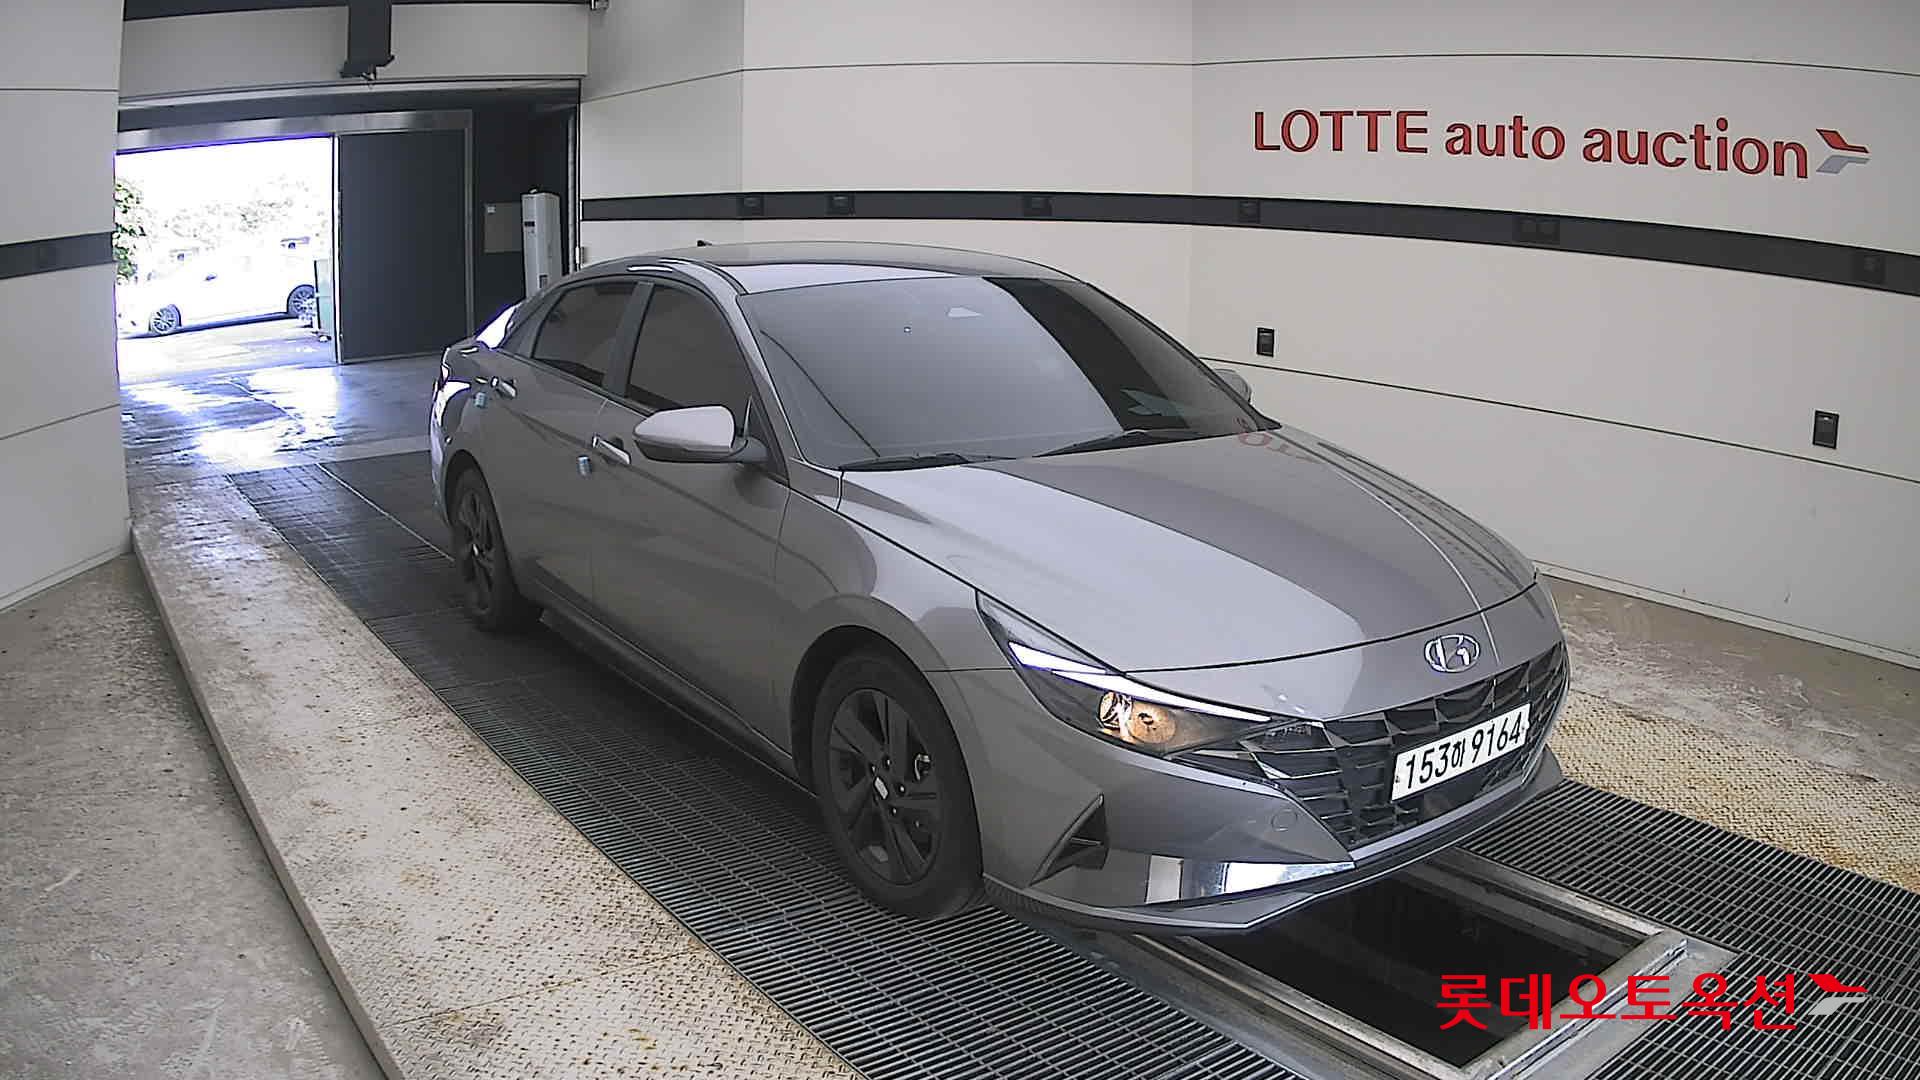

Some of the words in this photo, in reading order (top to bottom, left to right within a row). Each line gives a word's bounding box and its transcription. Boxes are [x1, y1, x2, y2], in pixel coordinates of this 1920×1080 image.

[1254, 110, 1428, 153] LOTTE
[1445, 115, 1566, 160] auto
[1582, 117, 1809, 179] auction
[1471, 711, 1523, 763] 9164
